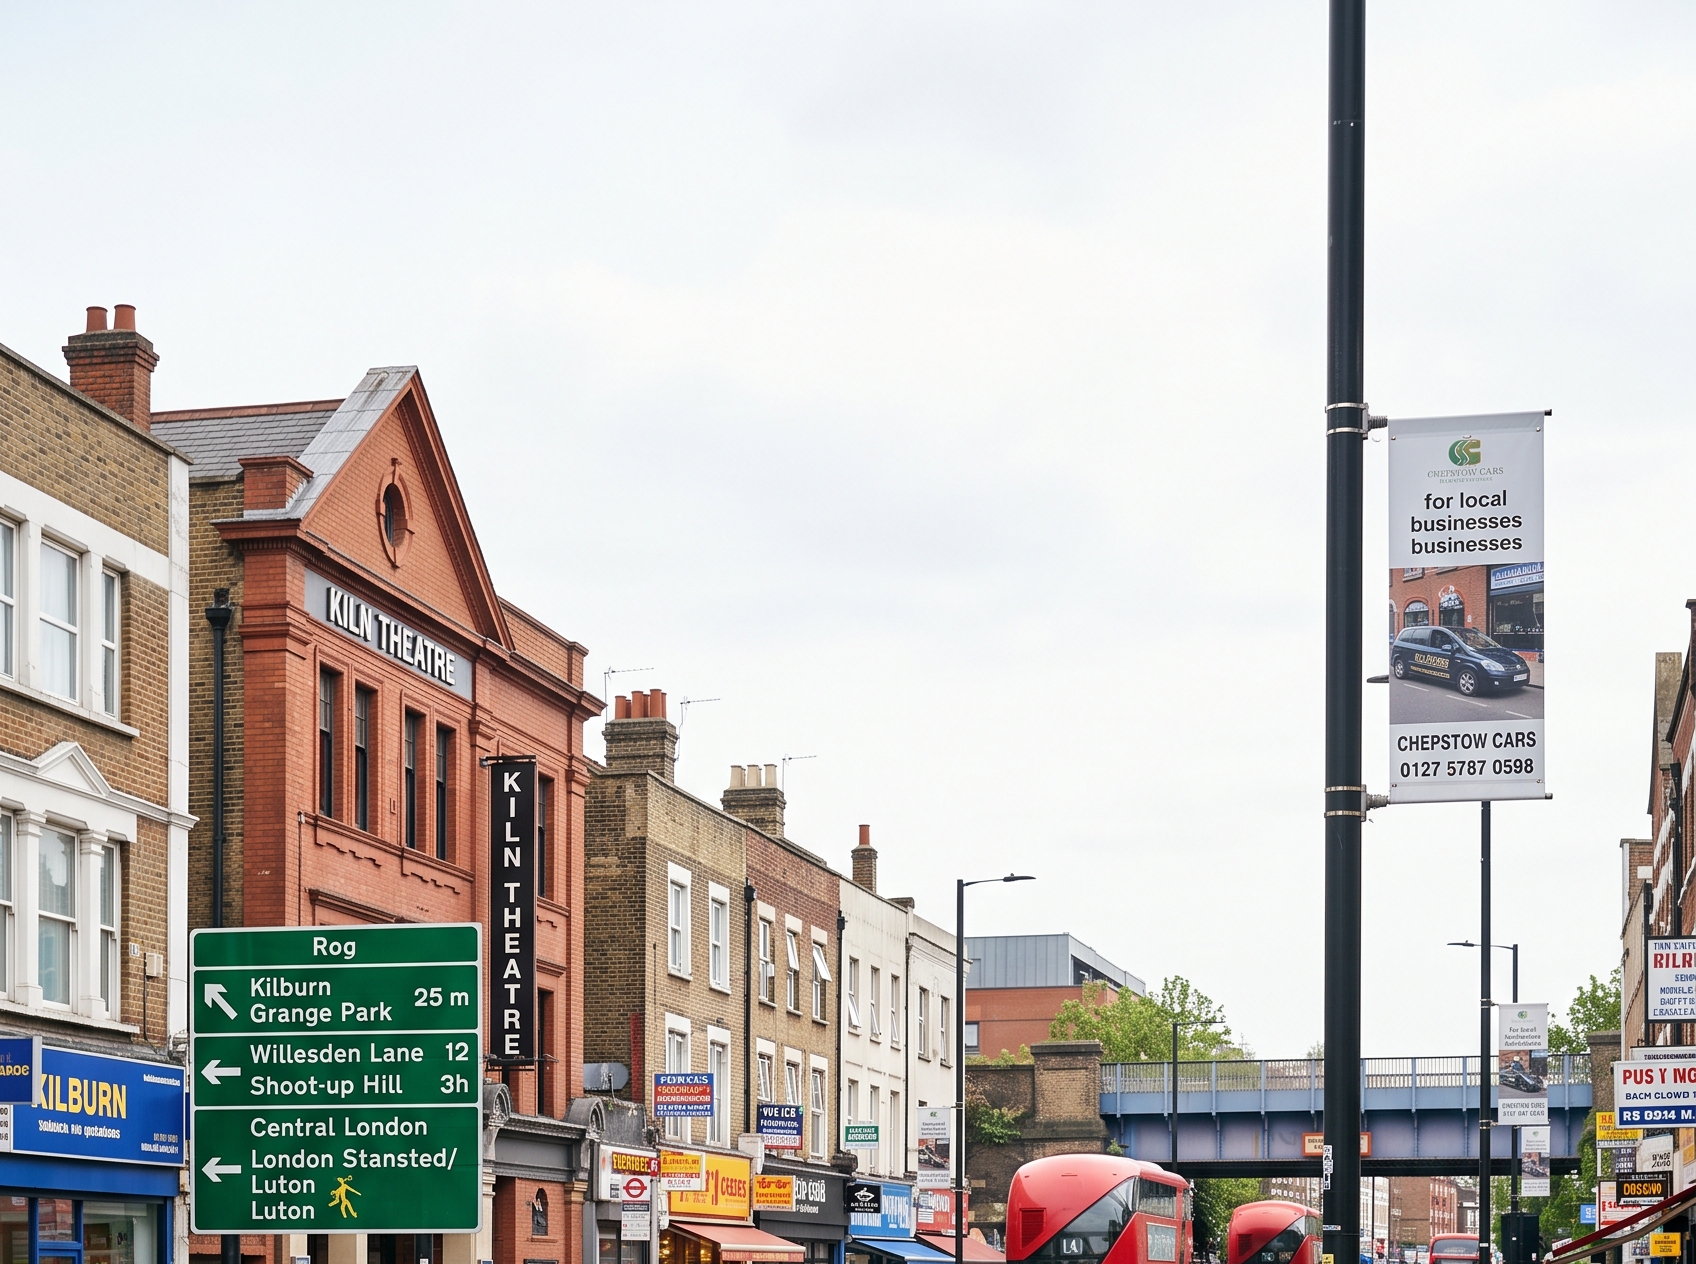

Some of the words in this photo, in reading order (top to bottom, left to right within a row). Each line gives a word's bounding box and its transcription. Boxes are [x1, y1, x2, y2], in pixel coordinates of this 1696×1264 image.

[1480, 467, 1504, 476] CARS
[1424, 493, 1453, 510] for
[1460, 490, 1507, 509] local
[1411, 514, 1522, 532] businesses
[1411, 537, 1523, 554] businesses
[327, 586, 372, 642] KILN
[376, 613, 456, 686] THEATRE
[1397, 733, 1488, 752] CHEPSTOW
[1492, 731, 1537, 749] CARS
[1400, 762, 1441, 778] 0127
[1447, 760, 1487, 777] 5787
[1492, 758, 1534, 775] 0598
[503, 771, 521, 867] KILN
[313, 937, 356, 959] Rog
[503, 882, 521, 1055] THEATRE
[250, 977, 331, 997] Kilburn
[414, 987, 443, 1007] 25
[450, 991, 469, 1006] m
[250, 1003, 332, 1027] Grange
[341, 1002, 393, 1022] Park
[250, 1044, 360, 1064] Willesden
[370, 1043, 424, 1063] Lane
[445, 1042, 469, 1061] 12
[32, 1073, 127, 1119] KILBURN
[250, 1076, 354, 1098] Shoot-up
[363, 1075, 403, 1094] Hill
[440, 1074, 469, 1093] 3h
[250, 1117, 335, 1137] Central
[345, 1116, 427, 1136] London
[251, 1149, 334, 1169] London
[342, 1147, 458, 1170] Stansted/
[251, 1174, 315, 1194] Luton
[251, 1200, 315, 1220] Luton
